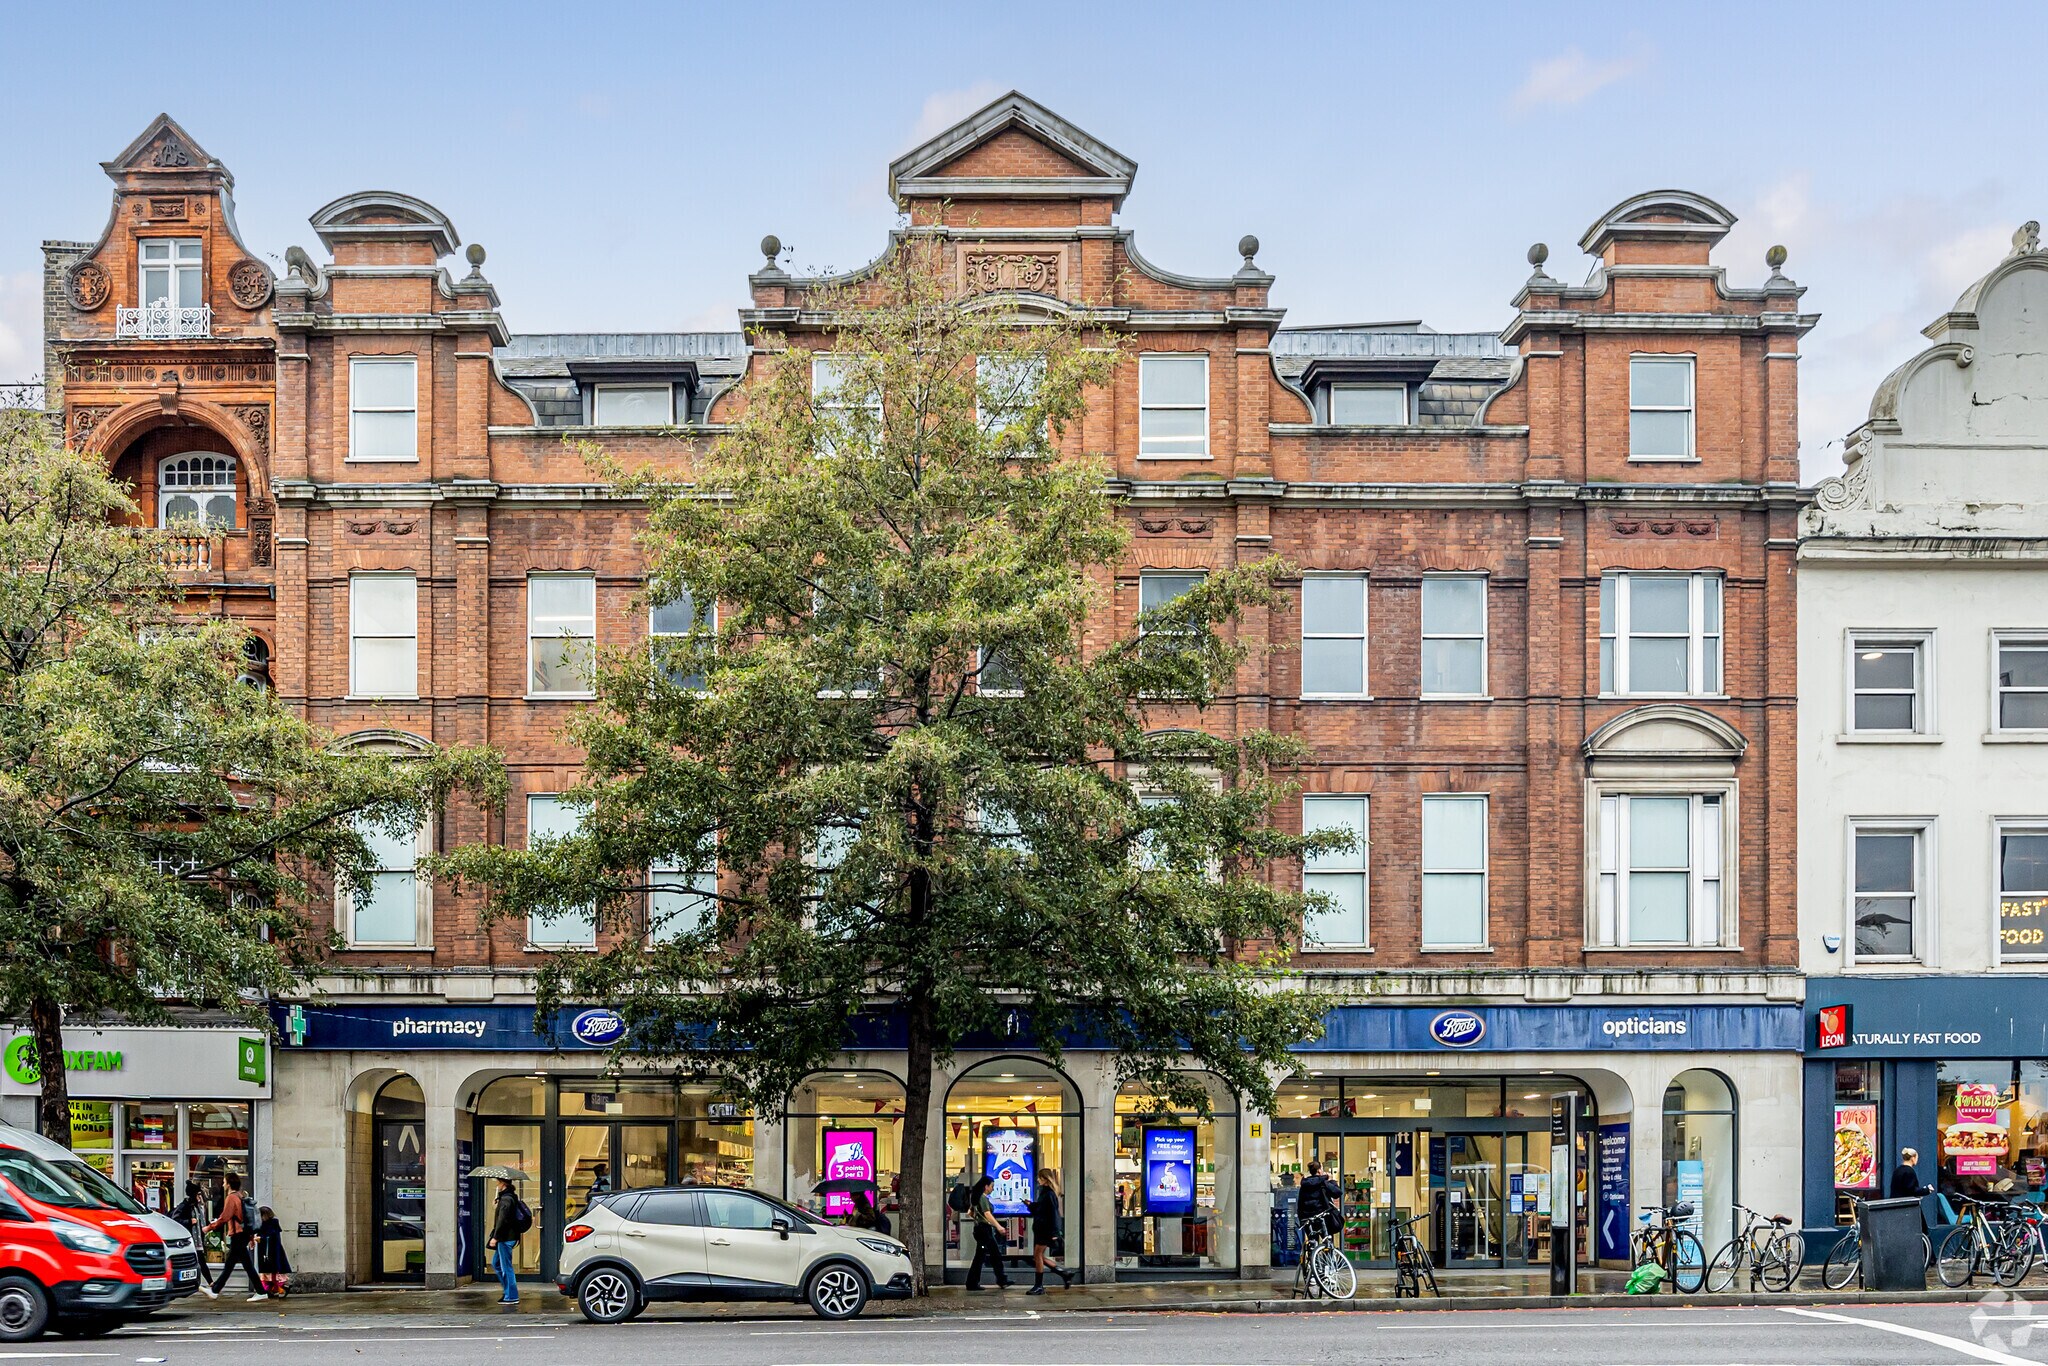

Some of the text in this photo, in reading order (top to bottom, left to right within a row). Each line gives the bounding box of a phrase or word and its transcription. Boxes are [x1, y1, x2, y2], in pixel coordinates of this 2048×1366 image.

[1026, 271, 1041, 283] 87
[2001, 901, 2042, 917] FAST
[393, 1016, 486, 1037] pharmacy
[580, 1017, 619, 1037] Boots
[1440, 1017, 1477, 1038] Boots
[1603, 1017, 1687, 1038] opticians
[1822, 1033, 1844, 1047] LEON
[1852, 1033, 1981, 1044] ATURALLY FAST FOOD
[82, 1103, 92, 1111] IN
[71, 1113, 100, 1121] HANGE
[73, 1123, 105, 1132] WORLD
[1251, 1124, 1261, 1137] H
[1603, 1136, 1625, 1146] welcome
[1002, 1143, 1018, 1153] 1/2
[836, 1165, 844, 1177] 3
